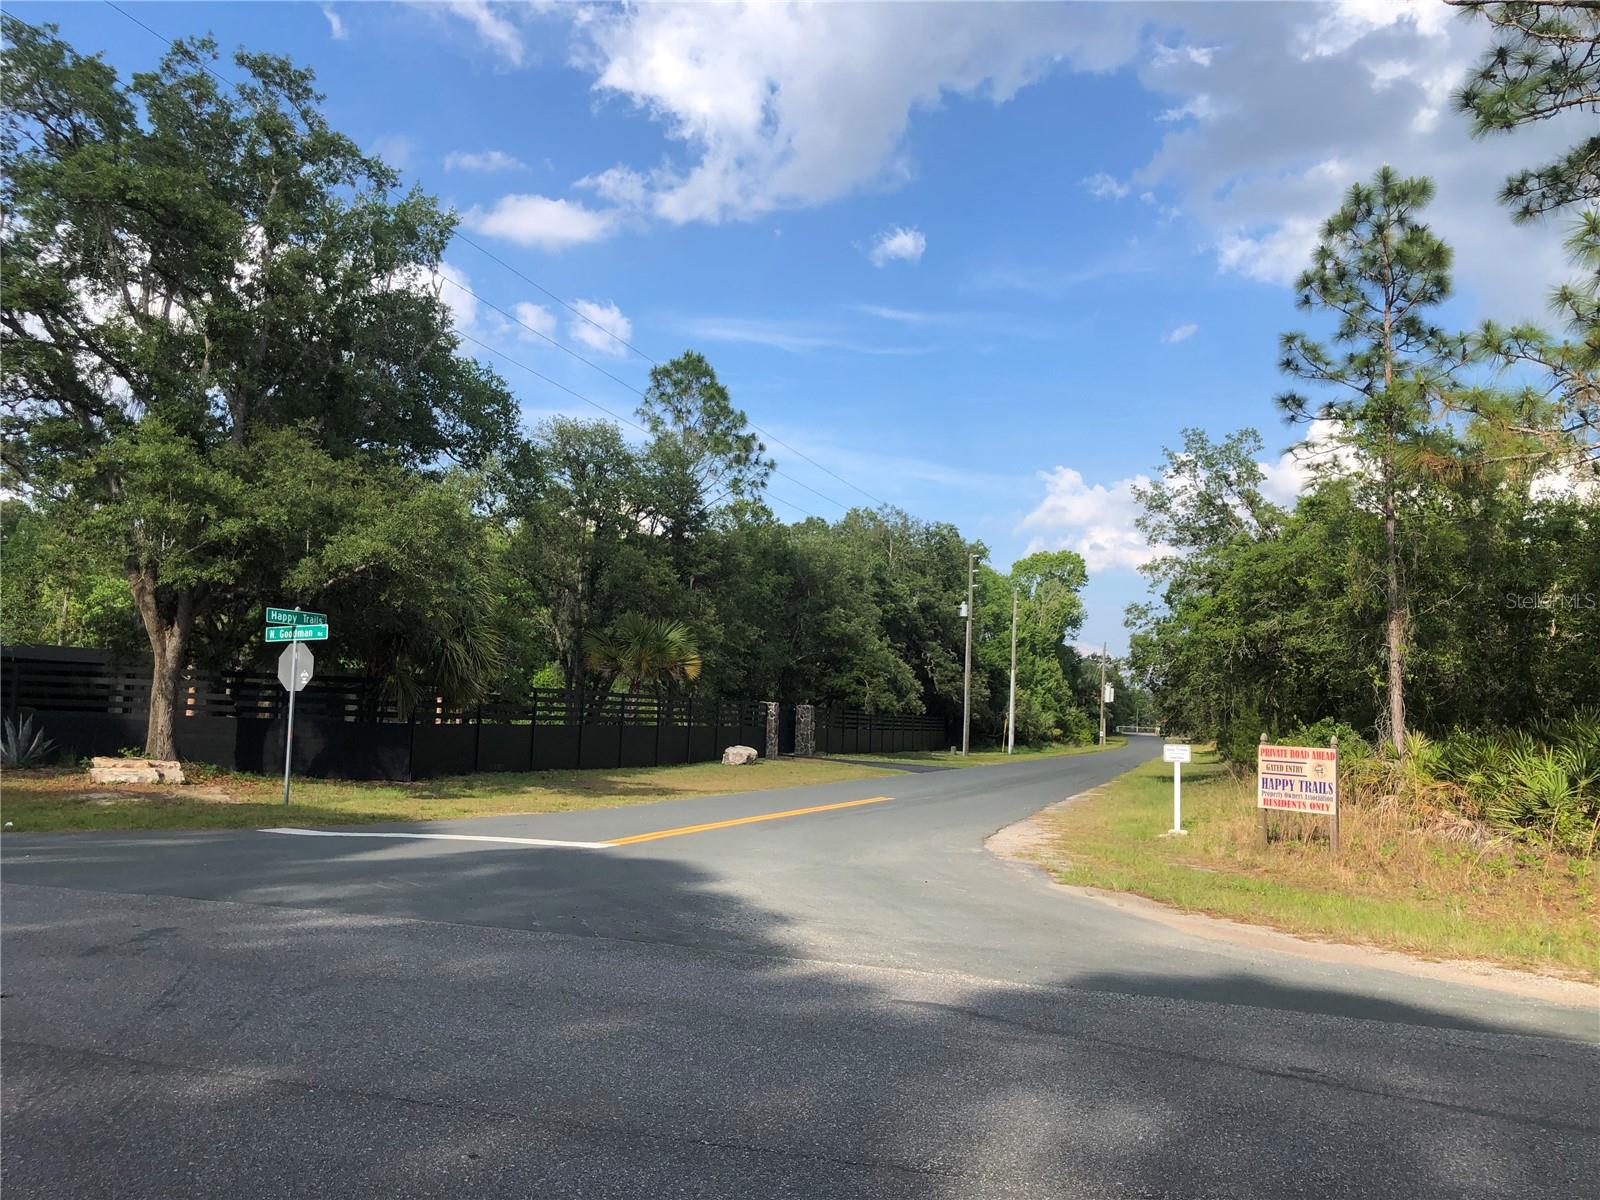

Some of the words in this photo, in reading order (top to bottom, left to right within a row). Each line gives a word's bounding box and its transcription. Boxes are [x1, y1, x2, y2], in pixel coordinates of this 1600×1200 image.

[271, 611, 297, 624] Happy
[303, 614, 323, 625] Trails
[269, 630, 277, 639] N.
[279, 629, 313, 638] Goodman
[1260, 748, 1288, 758] PRIVATE
[1290, 749, 1309, 759] ROAD
[1312, 751, 1335, 761] AHEAD
[1266, 763, 1284, 772] GATED
[1285, 764, 1303, 773] ENTRY
[1261, 777, 1295, 791] HAPPY
[1299, 780, 1334, 795] TRAILS
[1261, 791, 1283, 799] Property
[1305, 794, 1334, 802] Association
[1263, 798, 1307, 810] RESIDENTS
[1309, 801, 1330, 812] ONLY
